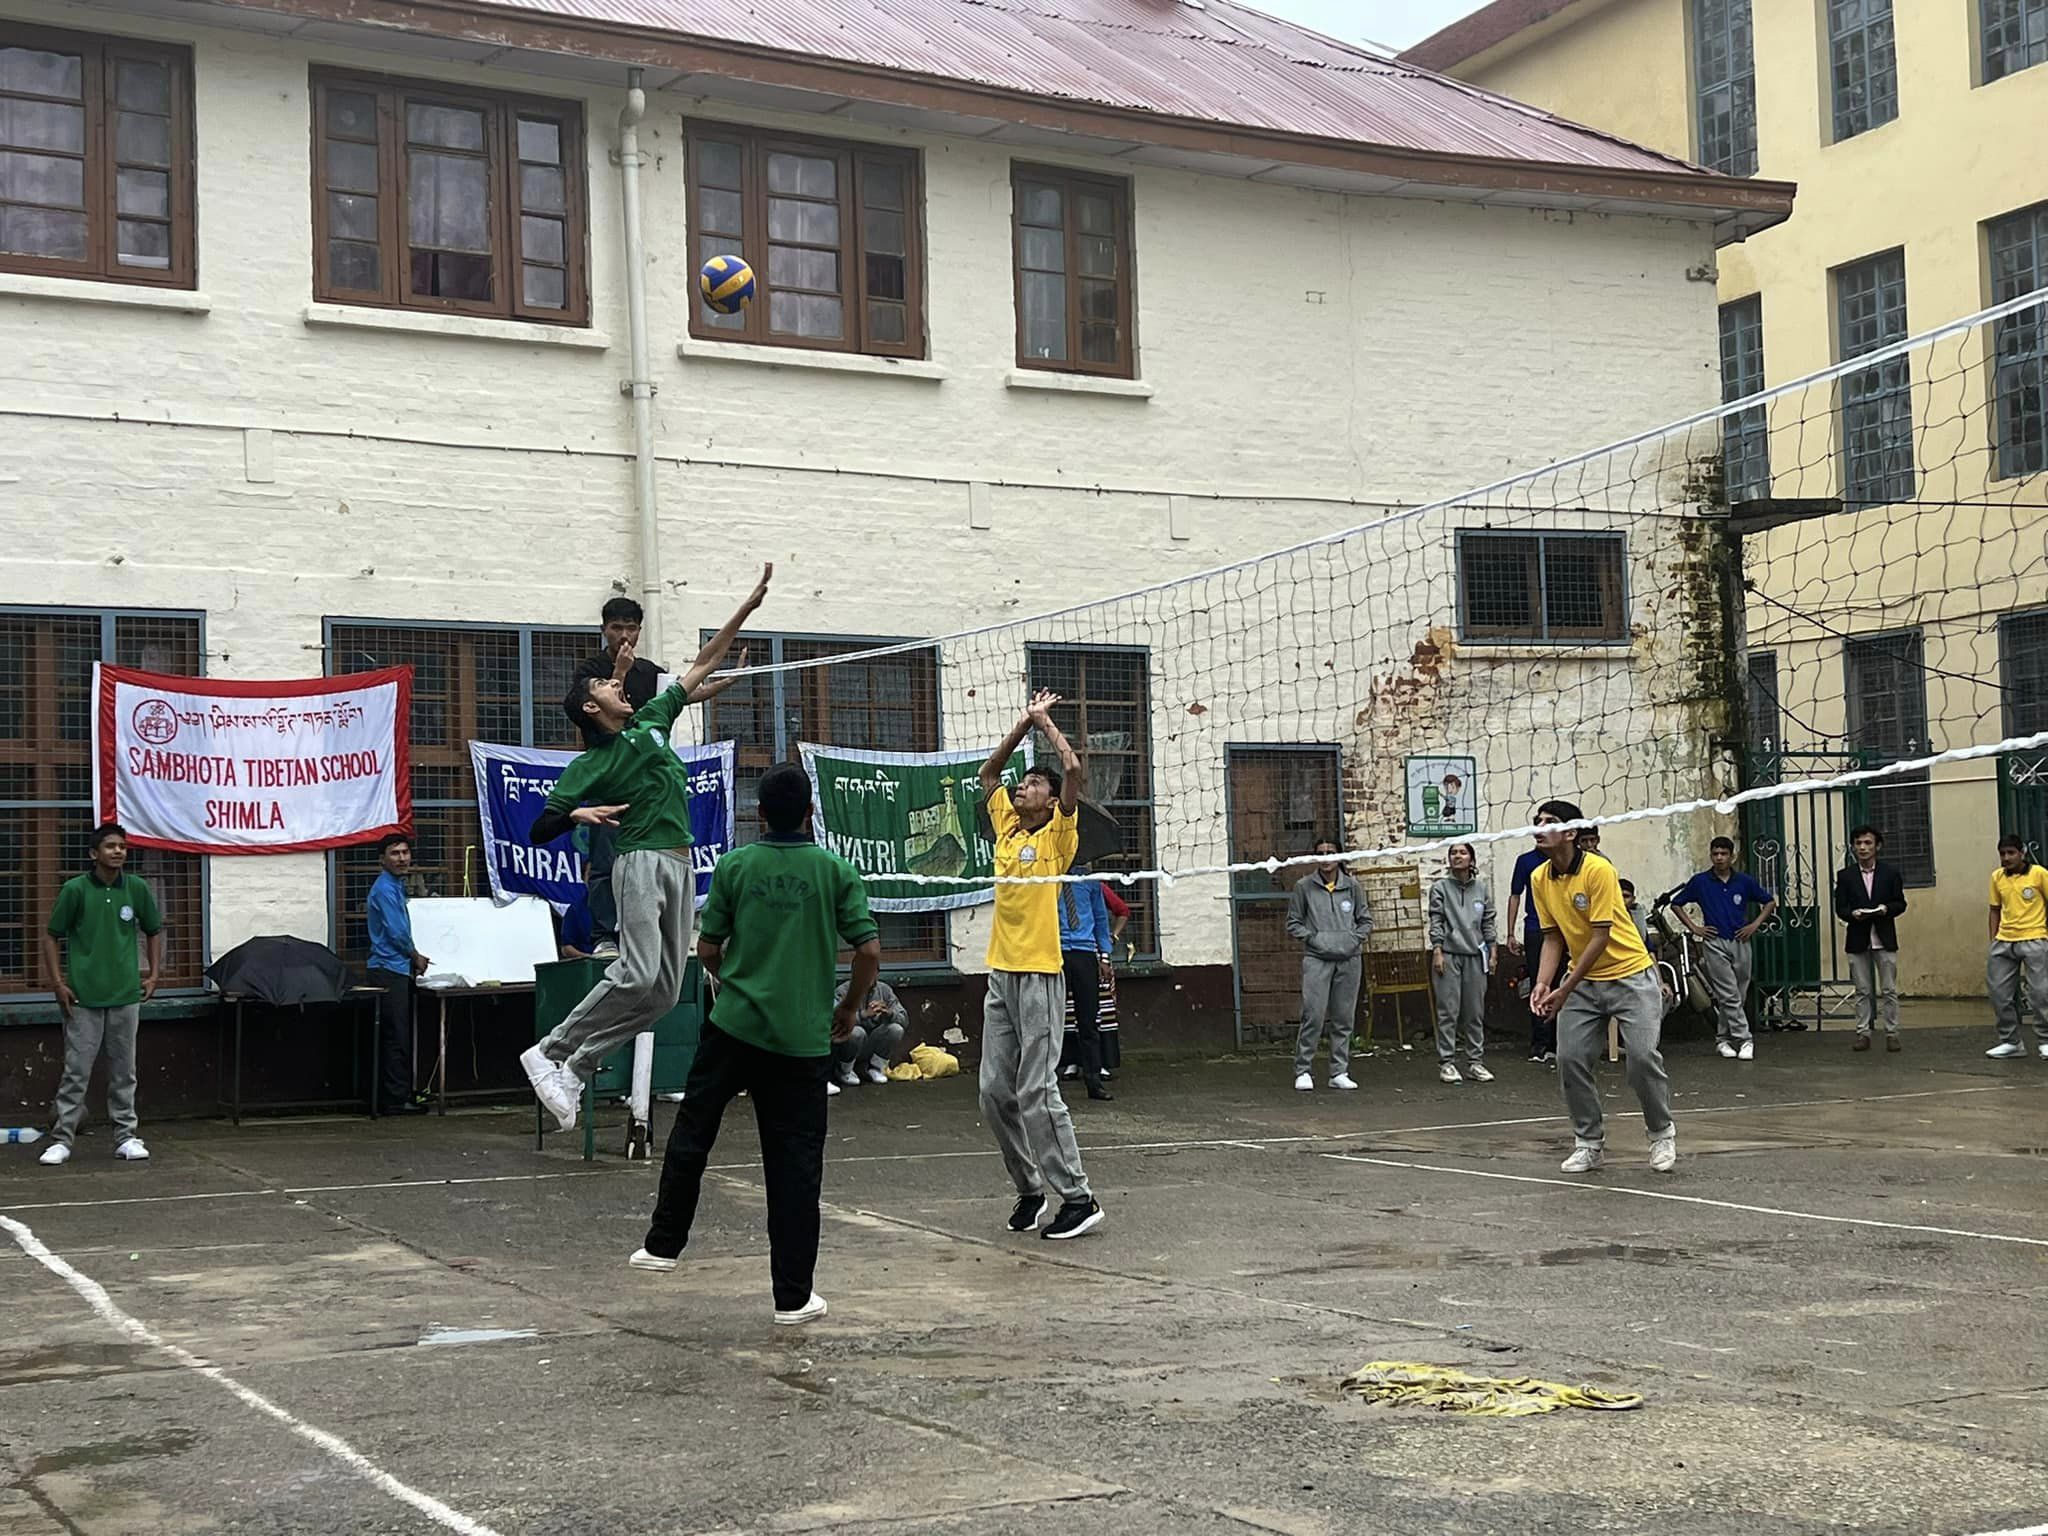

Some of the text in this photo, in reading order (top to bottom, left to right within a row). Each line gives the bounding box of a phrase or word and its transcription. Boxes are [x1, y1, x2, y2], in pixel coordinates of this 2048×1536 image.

[129, 746, 382, 788] SAMBHOTA TIBETAN SCHOOL
[204, 800, 285, 829] SHIMLA
[495, 839, 586, 884] TRIRAL
[827, 831, 897, 873] NYATRI
